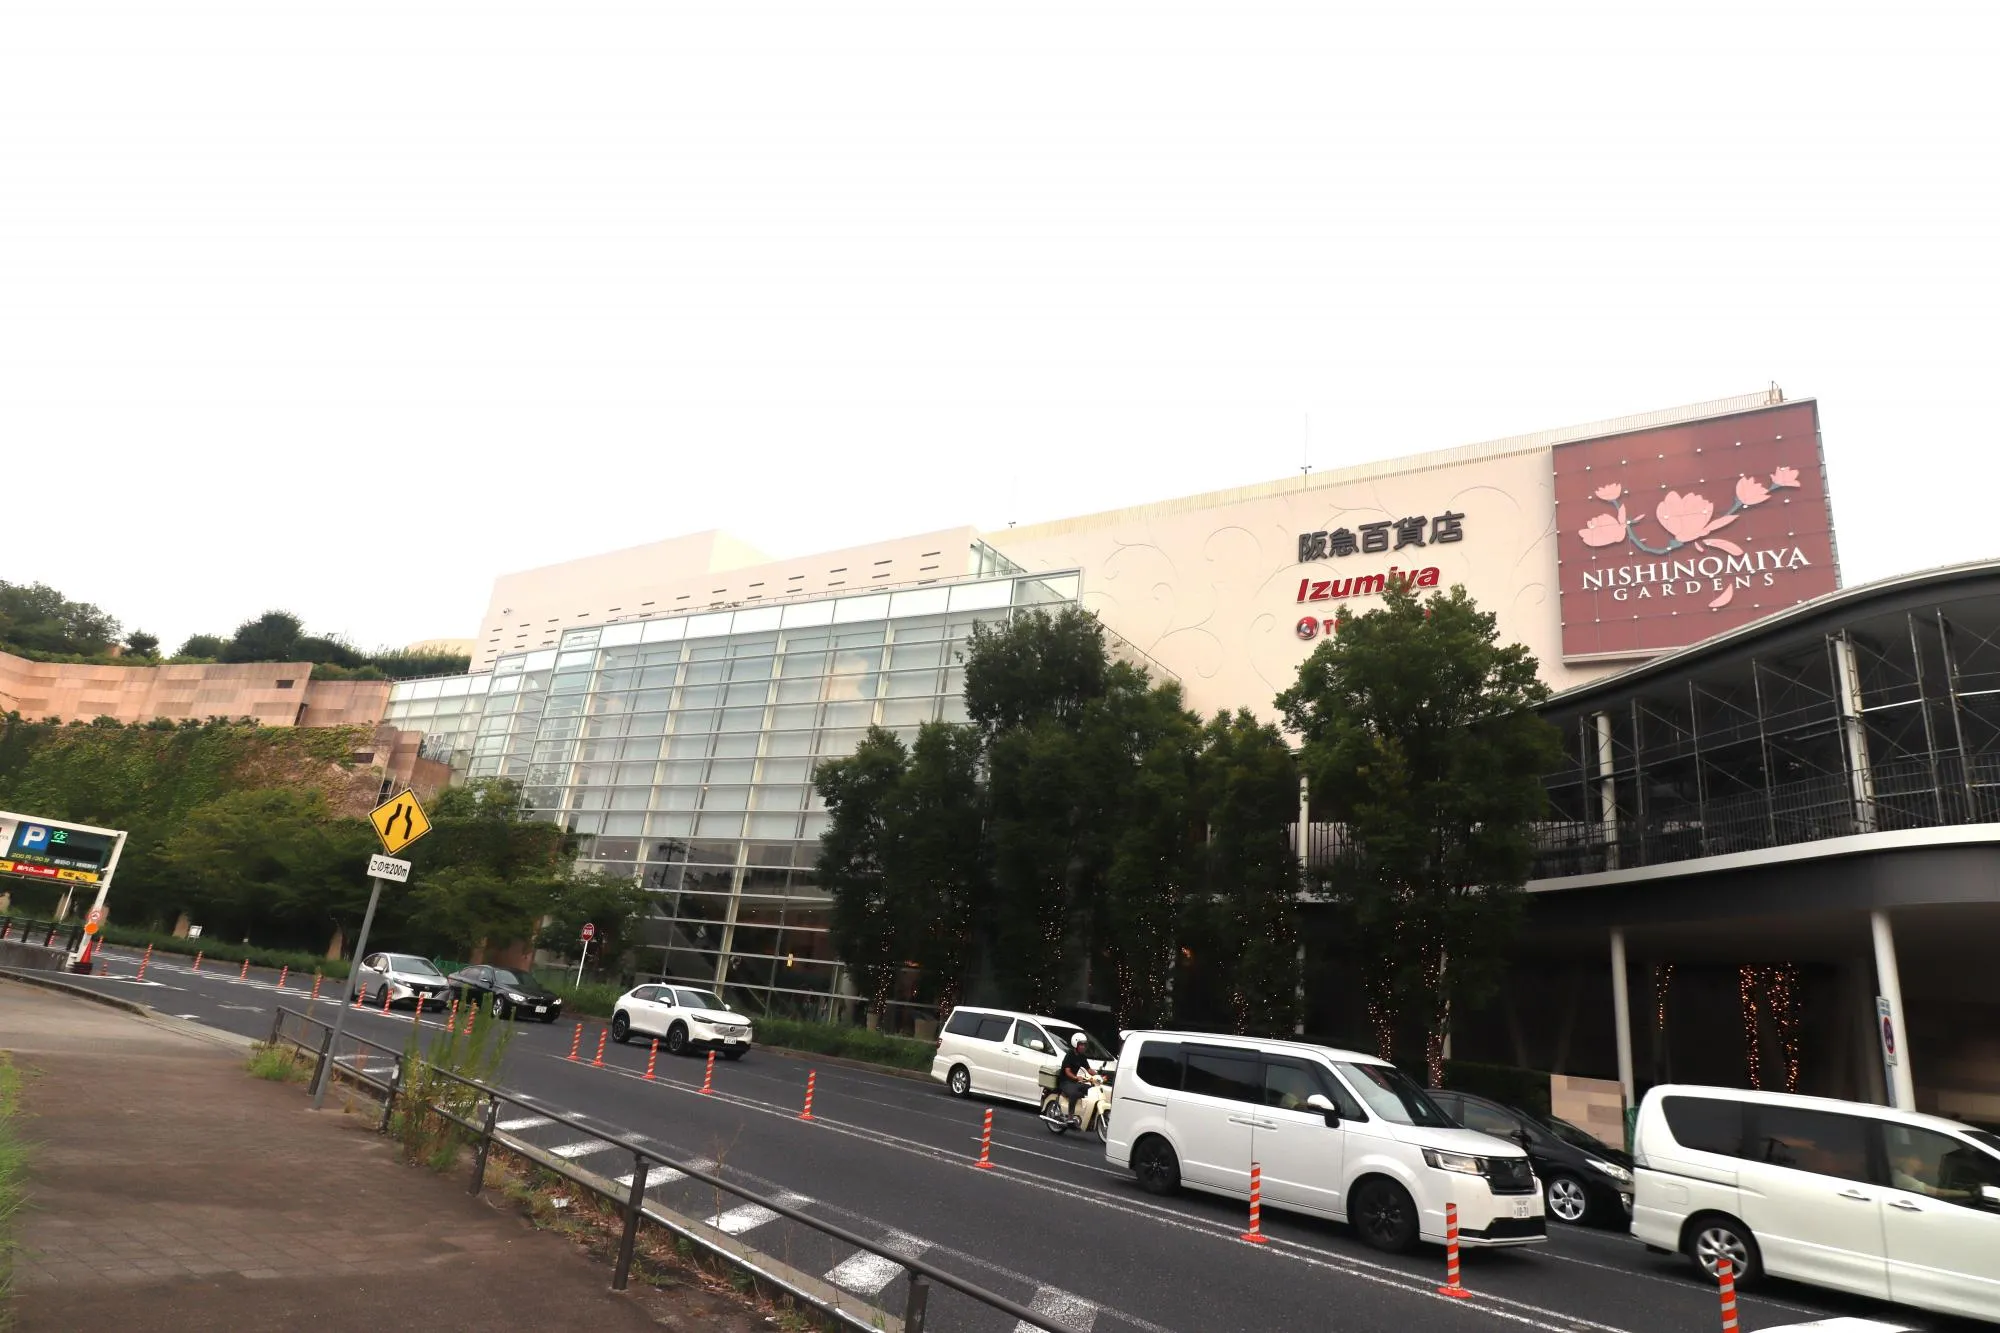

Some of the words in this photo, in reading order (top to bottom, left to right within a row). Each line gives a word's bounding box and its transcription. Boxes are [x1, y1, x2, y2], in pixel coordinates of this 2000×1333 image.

[1298, 510, 1465, 563] 阪急百貨店
[1582, 547, 1813, 590] NISHINOMIYA
[1613, 572, 1775, 602] GARDENS
[23, 825, 46, 846] P
[370, 860, 407, 876] この先200m
